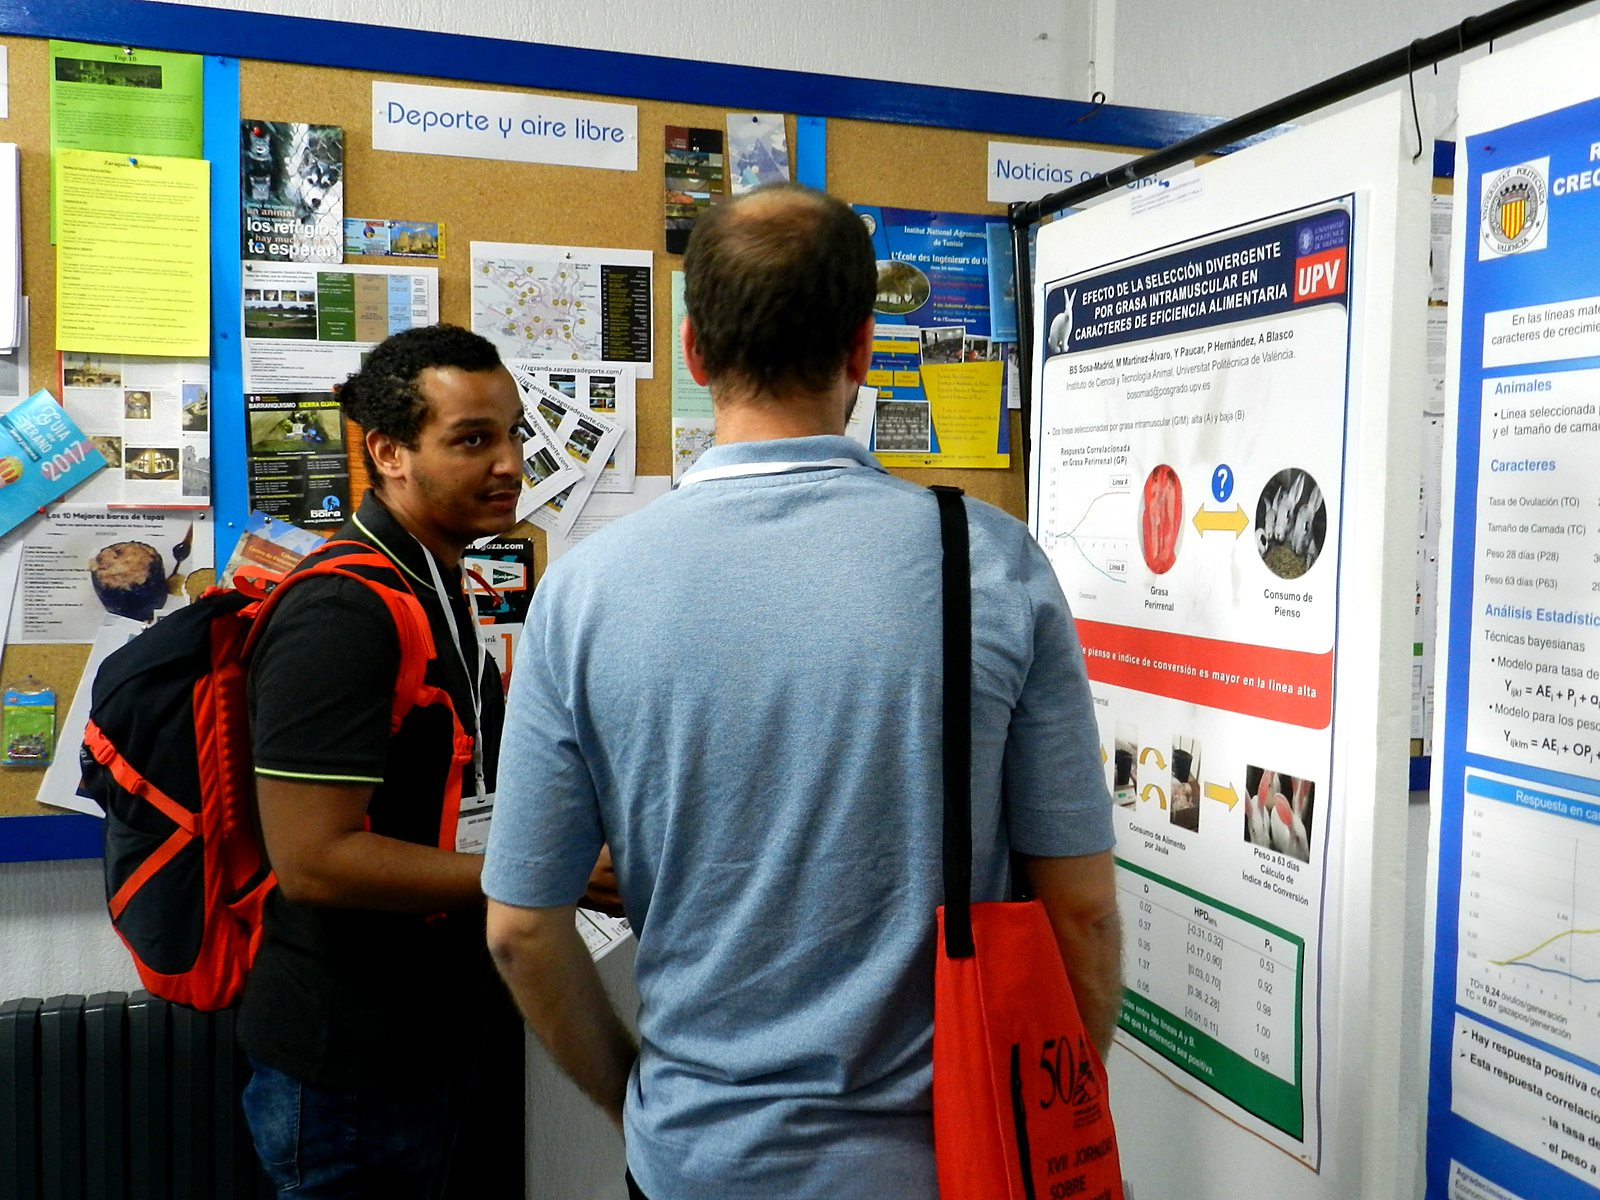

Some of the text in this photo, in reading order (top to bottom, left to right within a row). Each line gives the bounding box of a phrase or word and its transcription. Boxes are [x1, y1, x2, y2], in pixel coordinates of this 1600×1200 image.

[388, 101, 624, 143] Deporte y aire libre
[996, 159, 1073, 183] Noticias
[261, 208, 295, 217] animal
[247, 217, 338, 238] los refugios
[904, 226, 925, 234] Institut
[927, 227, 952, 236] National
[248, 238, 336, 258] te esperan
[1497, 238, 1529, 252] VALENCIA
[918, 253, 930, 262] des
[933, 254, 969, 264] Ingénieurs
[1082, 242, 1281, 305] EFECTO DE LA SELECCIÓN DIVERGENTE
[1298, 259, 1340, 296] UPV
[1095, 270, 1258, 319] POR GRASA INTRAMUSCULAR EN
[1075, 284, 1288, 340] CARACTERES DE EFICIENCIA ALIMENTARIA
[1512, 313, 1525, 325] En
[1527, 310, 1542, 324] las
[1545, 307, 1575, 321] líneas
[1492, 328, 1540, 345] caracteres
[1543, 327, 1556, 338] de
[1069, 365, 1078, 374] BS
[1116, 357, 1122, 367] M
[1174, 348, 1179, 357] Y
[1180, 343, 1206, 356] Paucar,
[1208, 342, 1213, 352] P
[1214, 335, 1256, 351] Hernández,
[1258, 333, 1265, 344] A
[1266, 328, 1294, 342] Blasco
[1088, 378, 1095, 387] de
[1096, 375, 1115, 386] Ciencia
[1116, 377, 1120, 385] y
[1121, 370, 1151, 383] Tecnología
[1176, 362, 1210, 375] Universitat
[1250, 354, 1260, 365] de
[1495, 378, 1552, 395] Animales
[1501, 404, 1595, 421] Línea seleccionada
[1493, 427, 1498, 439] y
[1501, 425, 1509, 435] el
[1514, 423, 1552, 436] tamaño
[1554, 423, 1566, 434] de
[41, 440, 85, 482] 2017
[1491, 459, 1556, 472] Caracteres
[1489, 497, 1579, 508] Tasa de Ovulación (TO)
[73, 513, 103, 521] Mejores
[1488, 523, 1586, 536] Tamaño de Camada (TC)
[1150, 586, 1169, 597] Grasa
[1264, 589, 1313, 603] Consumo de
[1144, 600, 1174, 612] Perirrenal
[1274, 606, 1301, 619] Pienso
[1485, 603, 1532, 620] Análisis
[1485, 629, 1585, 652] Técnicas bayesianas
[1088, 649, 1110, 659] pienso
[1118, 653, 1140, 665] índice
[1142, 657, 1150, 667] de
[1153, 661, 1196, 675] conversión
[1200, 669, 1209, 678] es
[1212, 672, 1240, 683] mayor
[1243, 677, 1254, 686] en
[1257, 677, 1265, 688] la
[1269, 679, 1293, 693] línea
[1297, 687, 1317, 698] alta
[1498, 656, 1599, 680] Modelo para tasa de
[1516, 790, 1583, 817] Respuesta en
[1254, 848, 1271, 862] Peso
[1278, 857, 1285, 867] 63
[1286, 860, 1300, 872] días
[1260, 865, 1293, 884] Cálculo de
[1242, 871, 1308, 906] Índice de Conversión
[1471, 1029, 1587, 1092] Hay respuesta positiva
[1039, 1036, 1074, 1109] 50
[1470, 1054, 1491, 1072] Esta
[1493, 1066, 1543, 1097] respuesta
[1549, 1116, 1600, 1150] la tasa de
[1549, 1142, 1596, 1174] el peso a
